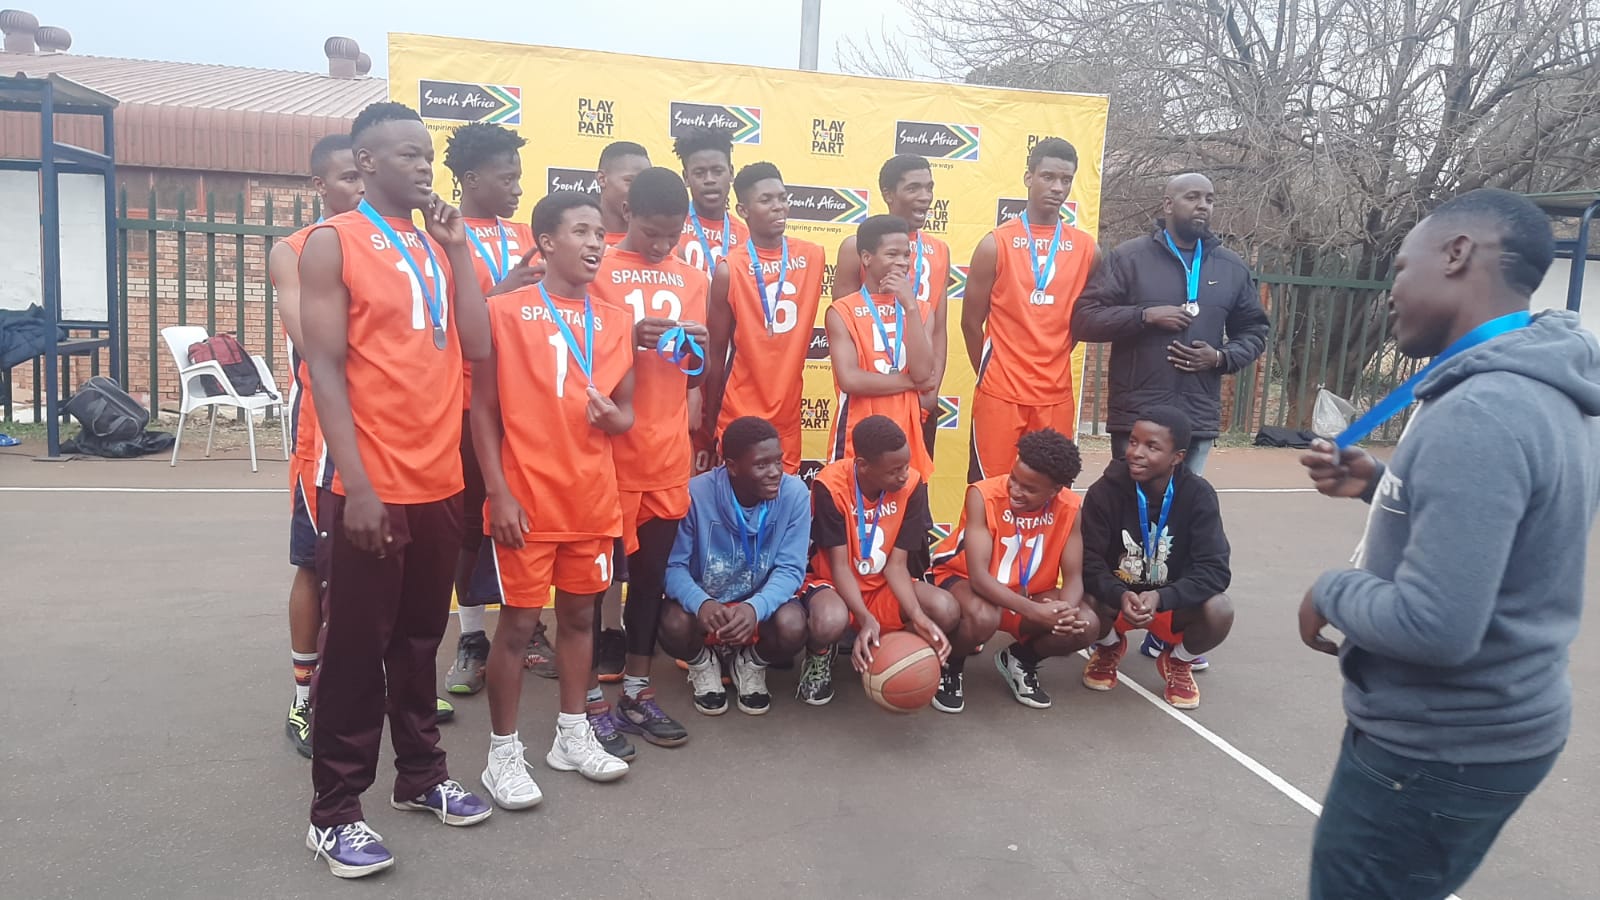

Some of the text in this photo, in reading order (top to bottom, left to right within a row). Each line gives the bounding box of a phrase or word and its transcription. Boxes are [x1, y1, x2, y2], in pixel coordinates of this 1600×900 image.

[425, 89, 496, 108] South Africa
[578, 98, 614, 113] PLAY
[578, 121, 614, 135] PART
[674, 111, 738, 129] South Africa
[812, 118, 845, 133] PLAY
[900, 130, 959, 147] South Africa
[812, 141, 844, 154] PART
[552, 176, 585, 193] South
[786, 193, 846, 210] South Africa
[923, 221, 948, 232] ART
[611, 270, 685, 288] SPARTANS
[1030, 255, 1056, 305] 2
[763, 281, 798, 334] 6
[624, 288, 682, 352] 12
[872, 322, 907, 375] 5
[548, 330, 568, 398] 1
[800, 398, 830, 410] PLAY
[800, 418, 829, 429] PART
[594, 553, 609, 582] 1
[997, 533, 1044, 585] 11
